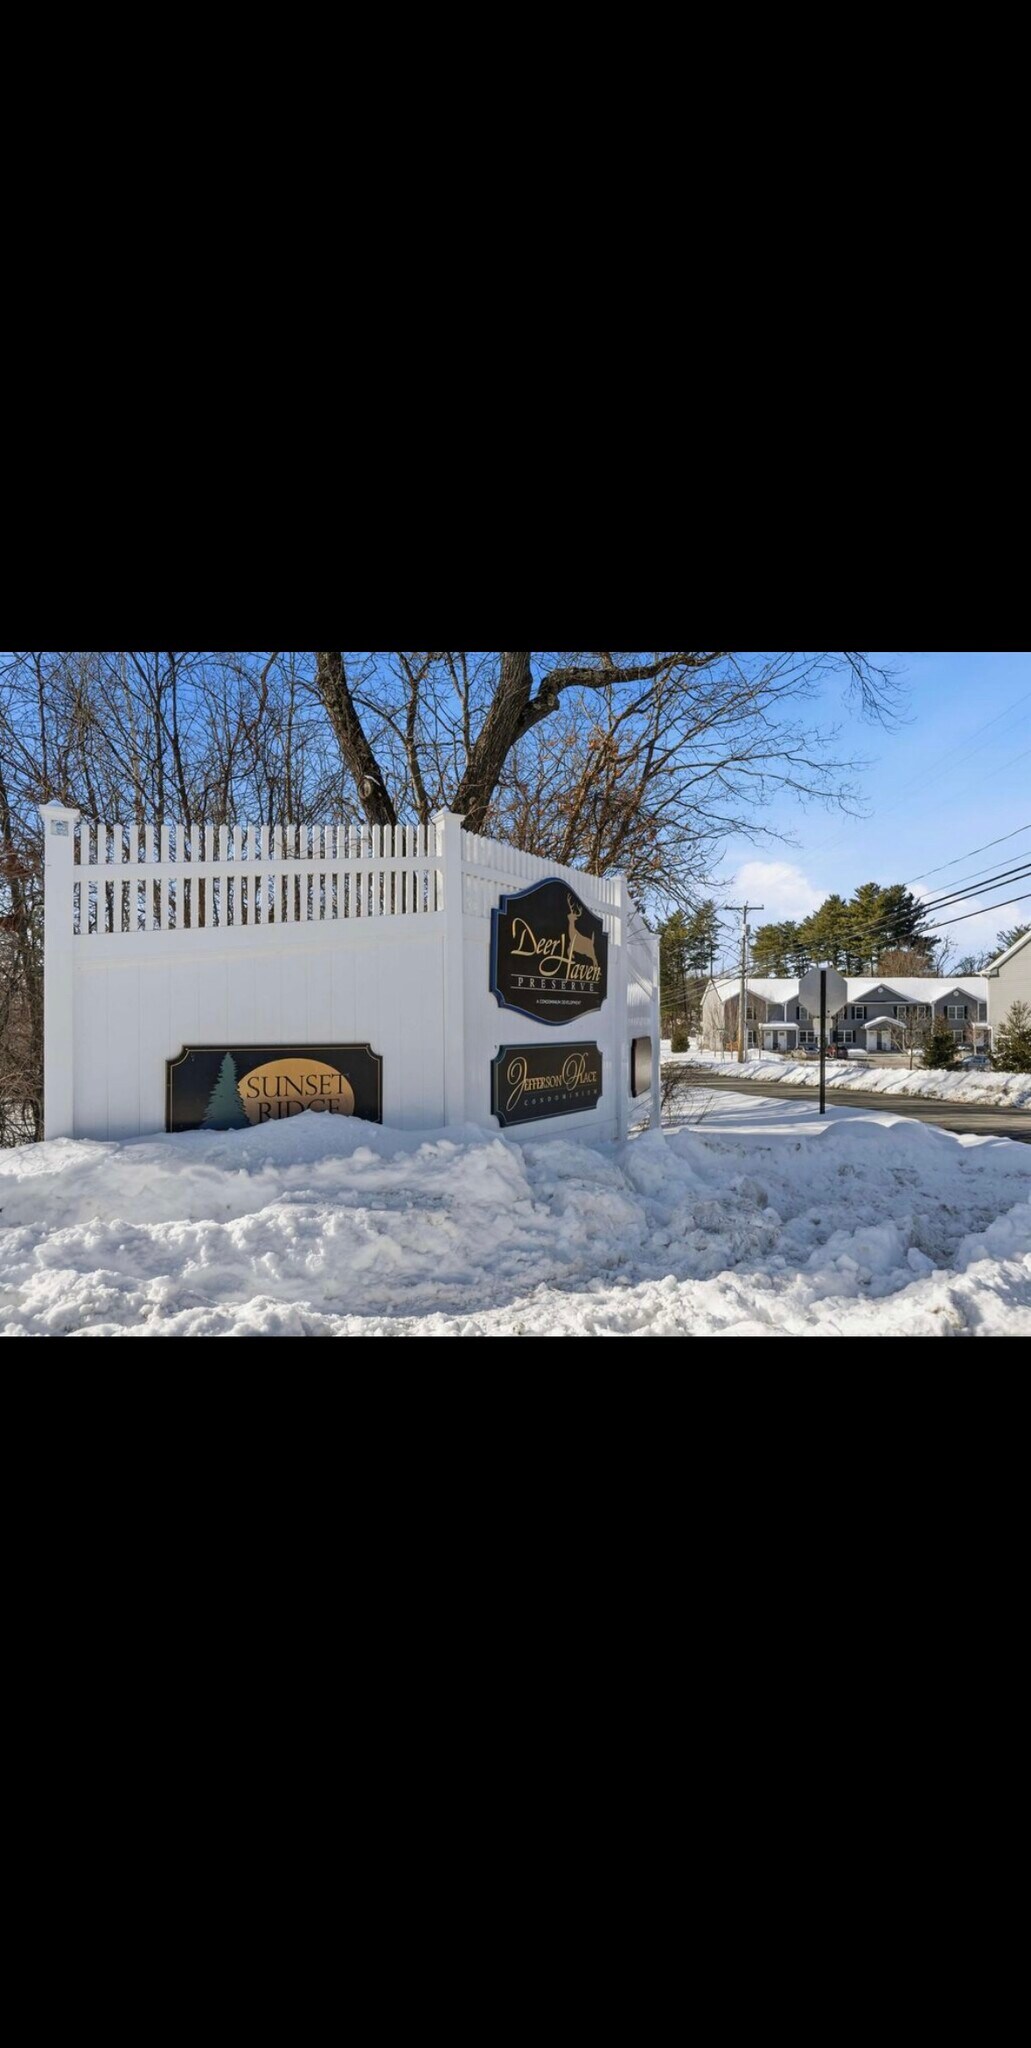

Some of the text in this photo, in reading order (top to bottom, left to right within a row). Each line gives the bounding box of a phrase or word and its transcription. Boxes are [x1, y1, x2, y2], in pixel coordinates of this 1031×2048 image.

[510, 917, 602, 981] Deer Haven
[517, 976, 595, 992] PRESERVE
[246, 1073, 345, 1099] SUNSET
[505, 1052, 598, 1112] JEFFERSON PLACE
[523, 1088, 598, 1106] CONDOMINIUM
